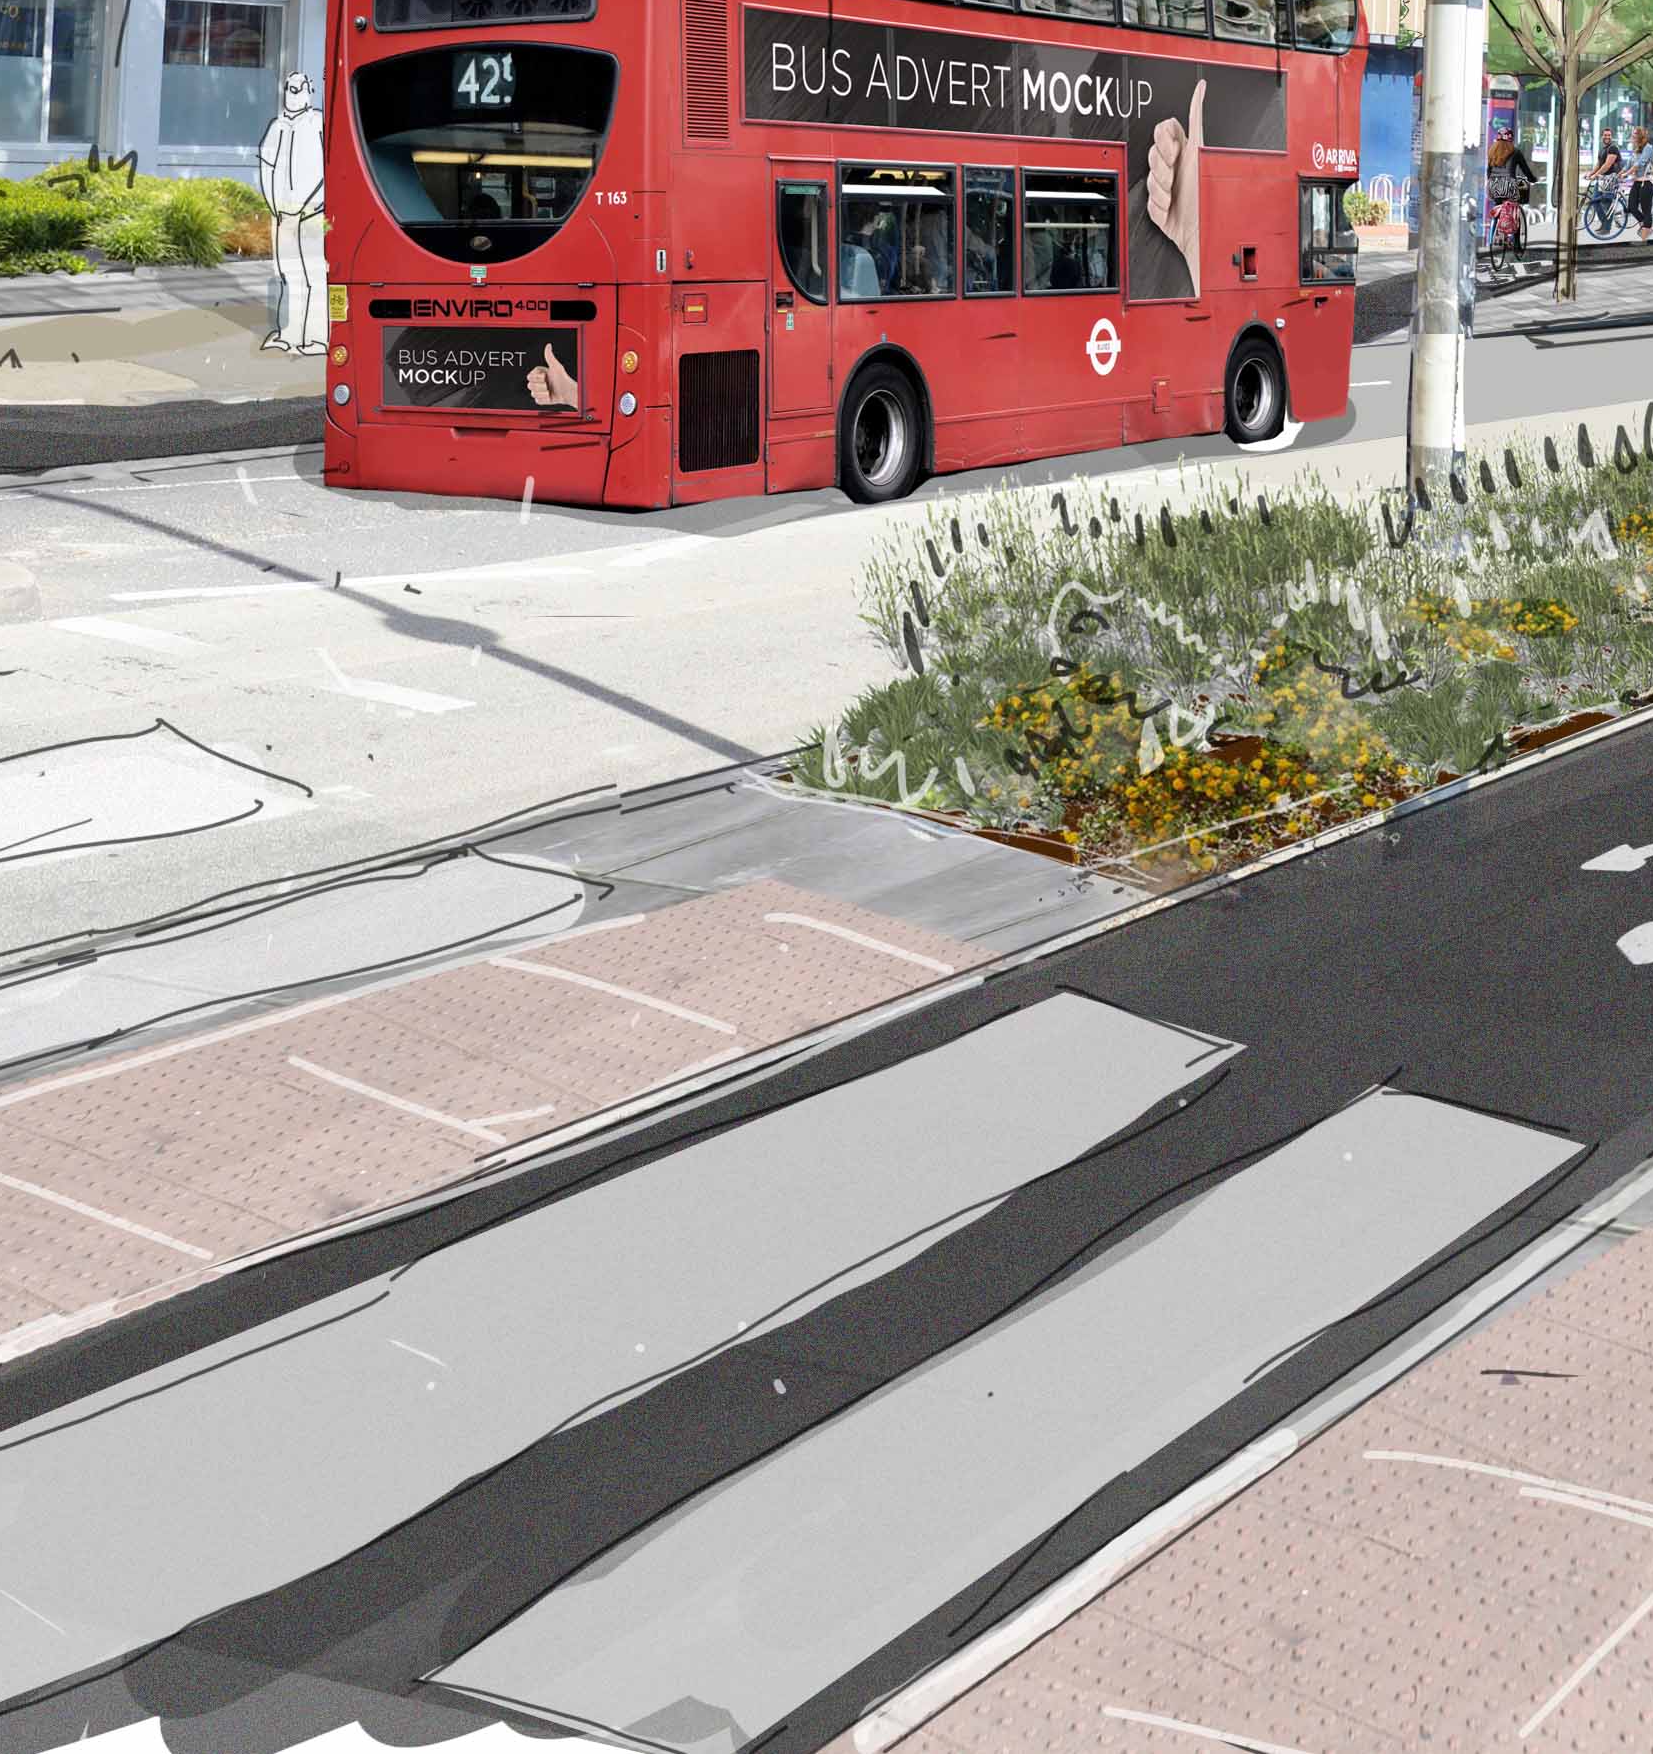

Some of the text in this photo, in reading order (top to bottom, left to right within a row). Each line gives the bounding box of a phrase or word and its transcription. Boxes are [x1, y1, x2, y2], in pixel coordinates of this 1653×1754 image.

[772, 43, 1154, 119] BUS ADVERT MOCKUP
[1326, 149, 1357, 165] ARRIVA
[595, 192, 627, 205] T 163
[398, 349, 527, 367] BUS ADVERT
[398, 369, 487, 386] MOCKUP
